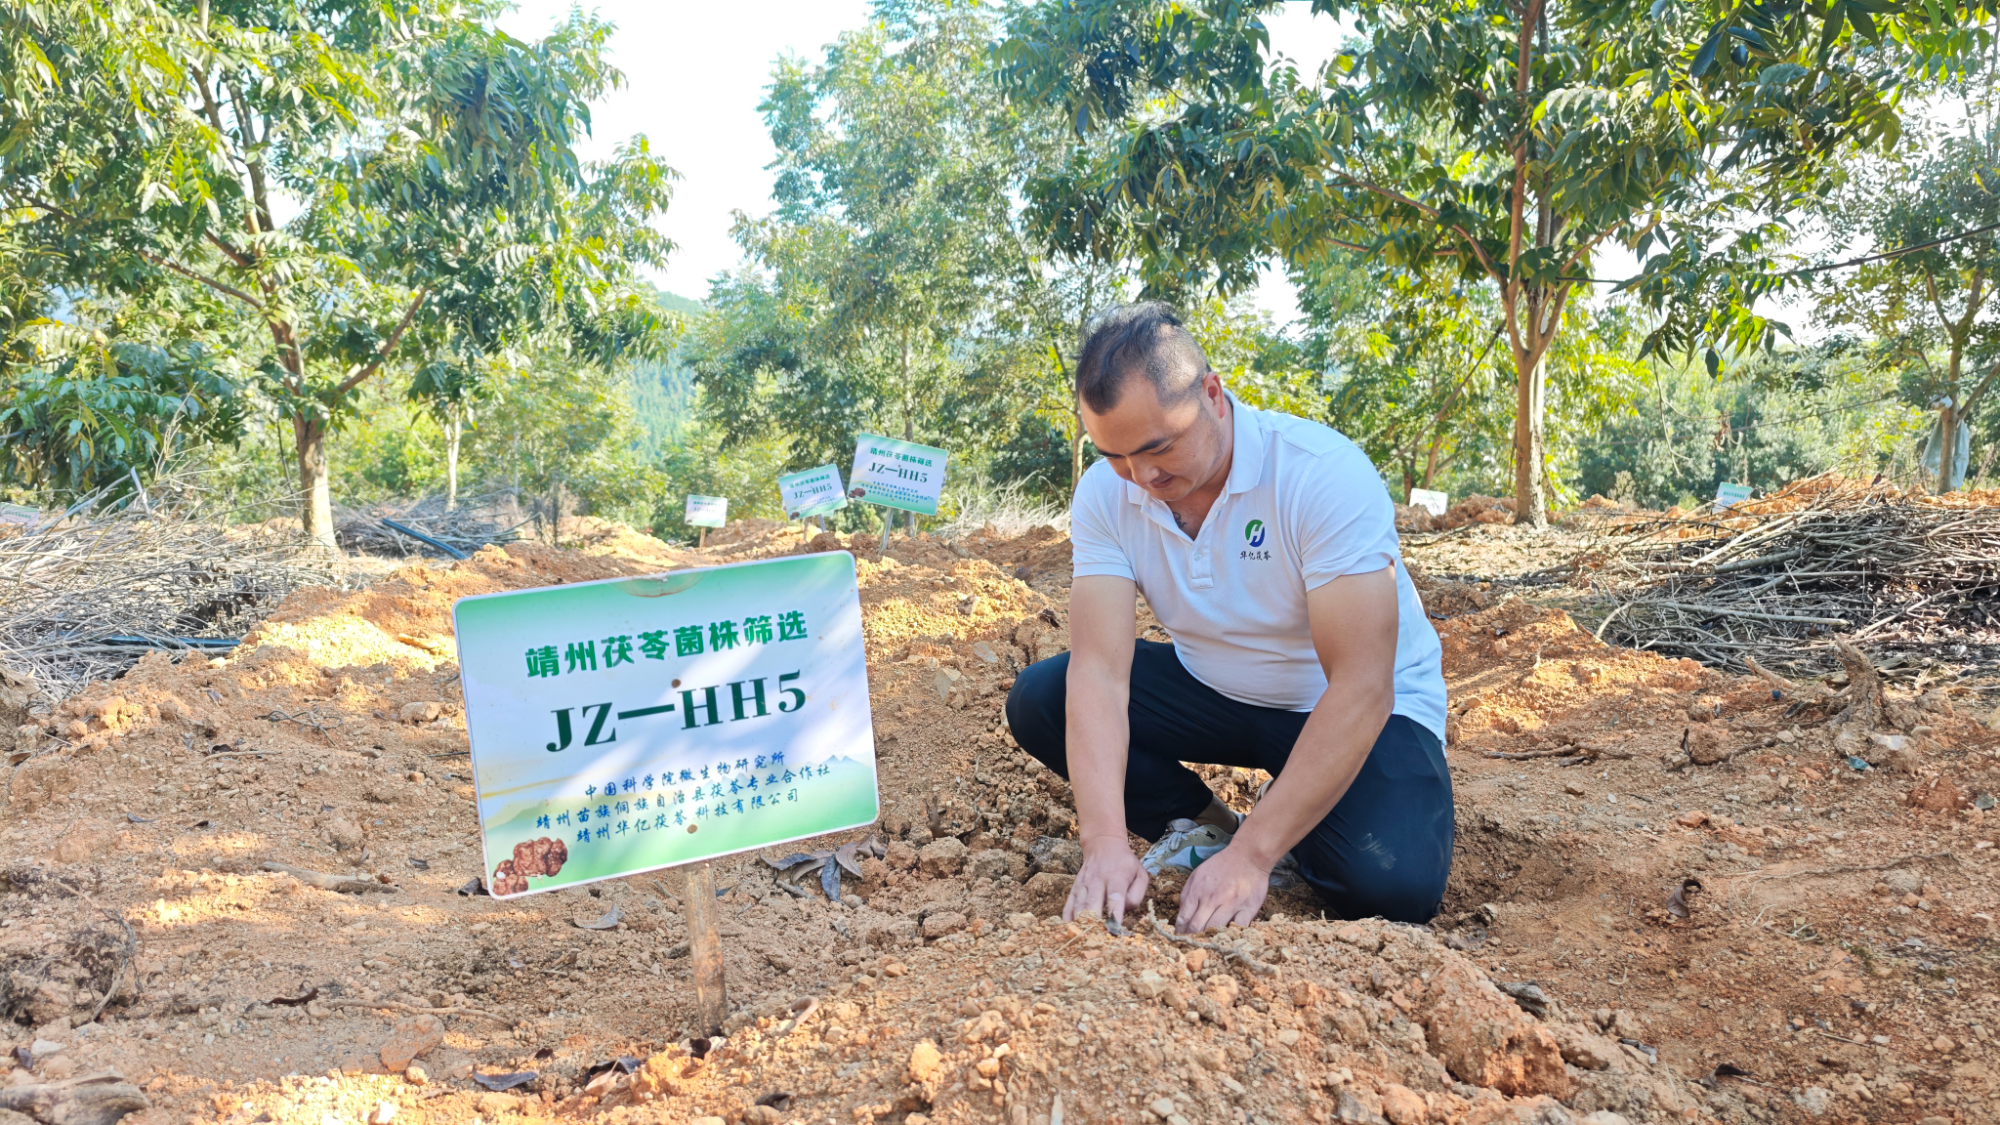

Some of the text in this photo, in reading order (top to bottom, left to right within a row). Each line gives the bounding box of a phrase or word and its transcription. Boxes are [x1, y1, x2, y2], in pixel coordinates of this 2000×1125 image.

[525, 610, 808, 678] 靖州茯苓菌株筛选
[536, 764, 830, 829] 靖州苗族侗族自治县茯苓专业合作社
[585, 751, 785, 801] 中国科学院微生物研究所
[576, 788, 798, 843] 靖州华亿茯苓科技有限公司
